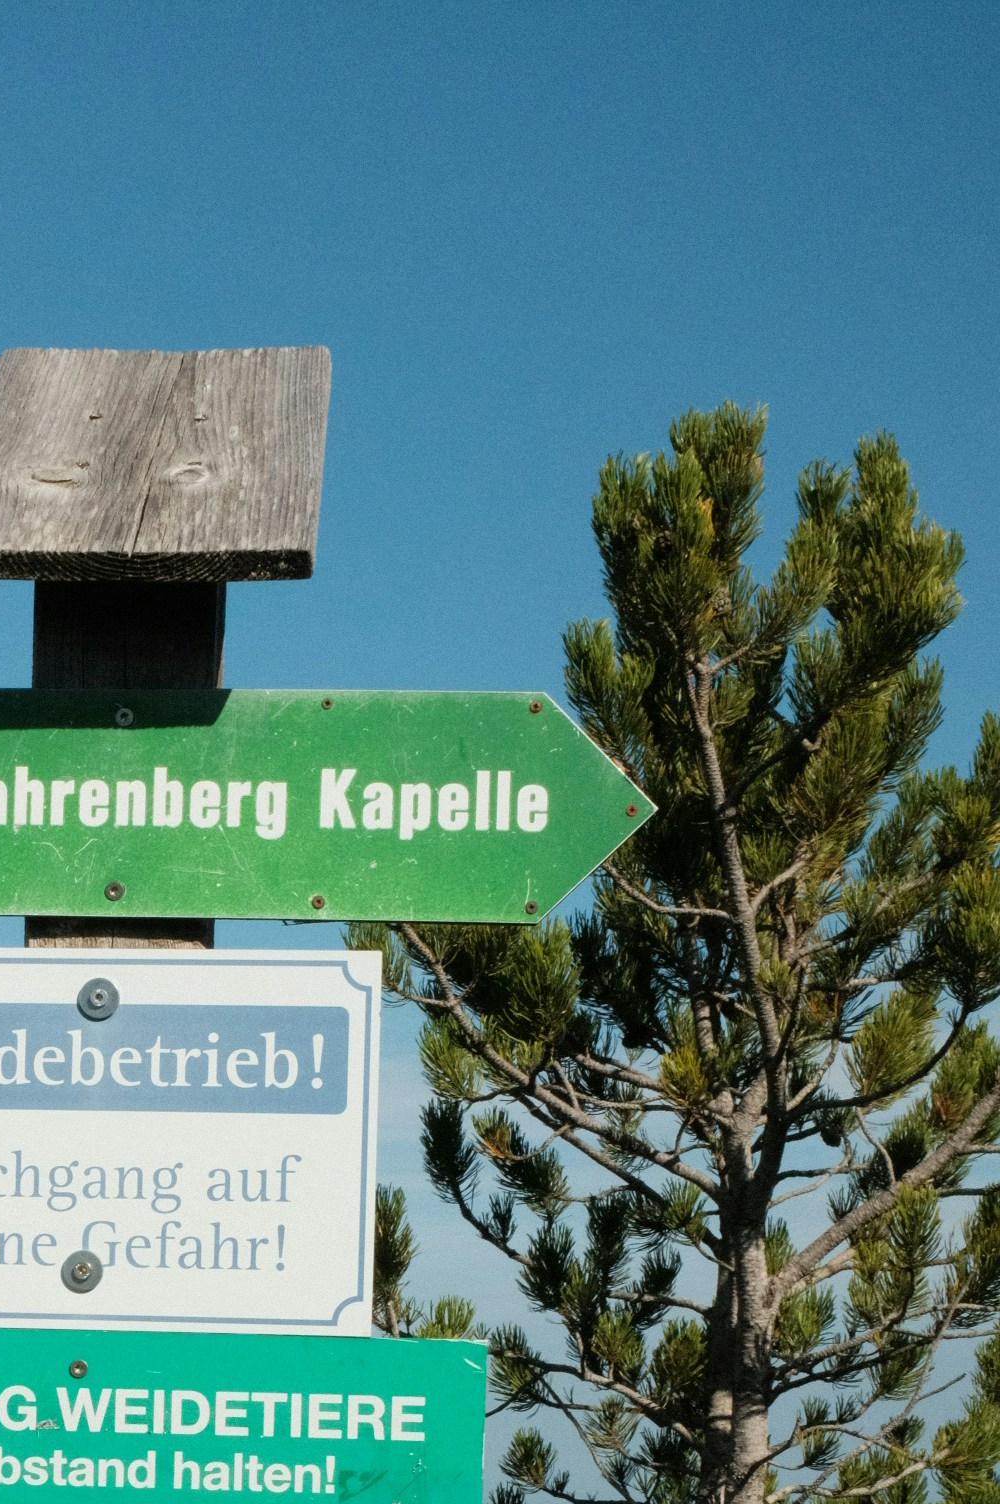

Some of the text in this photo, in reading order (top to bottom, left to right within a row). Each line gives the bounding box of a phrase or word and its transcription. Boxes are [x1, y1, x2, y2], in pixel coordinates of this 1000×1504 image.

[319, 767, 549, 840] Kapelle
[206, 1155, 302, 1203] auf
[81, 1220, 287, 1272] Gefahr!
[55, 1387, 427, 1442] WEIDETIERE
[173, 1452, 337, 1494] halten!
